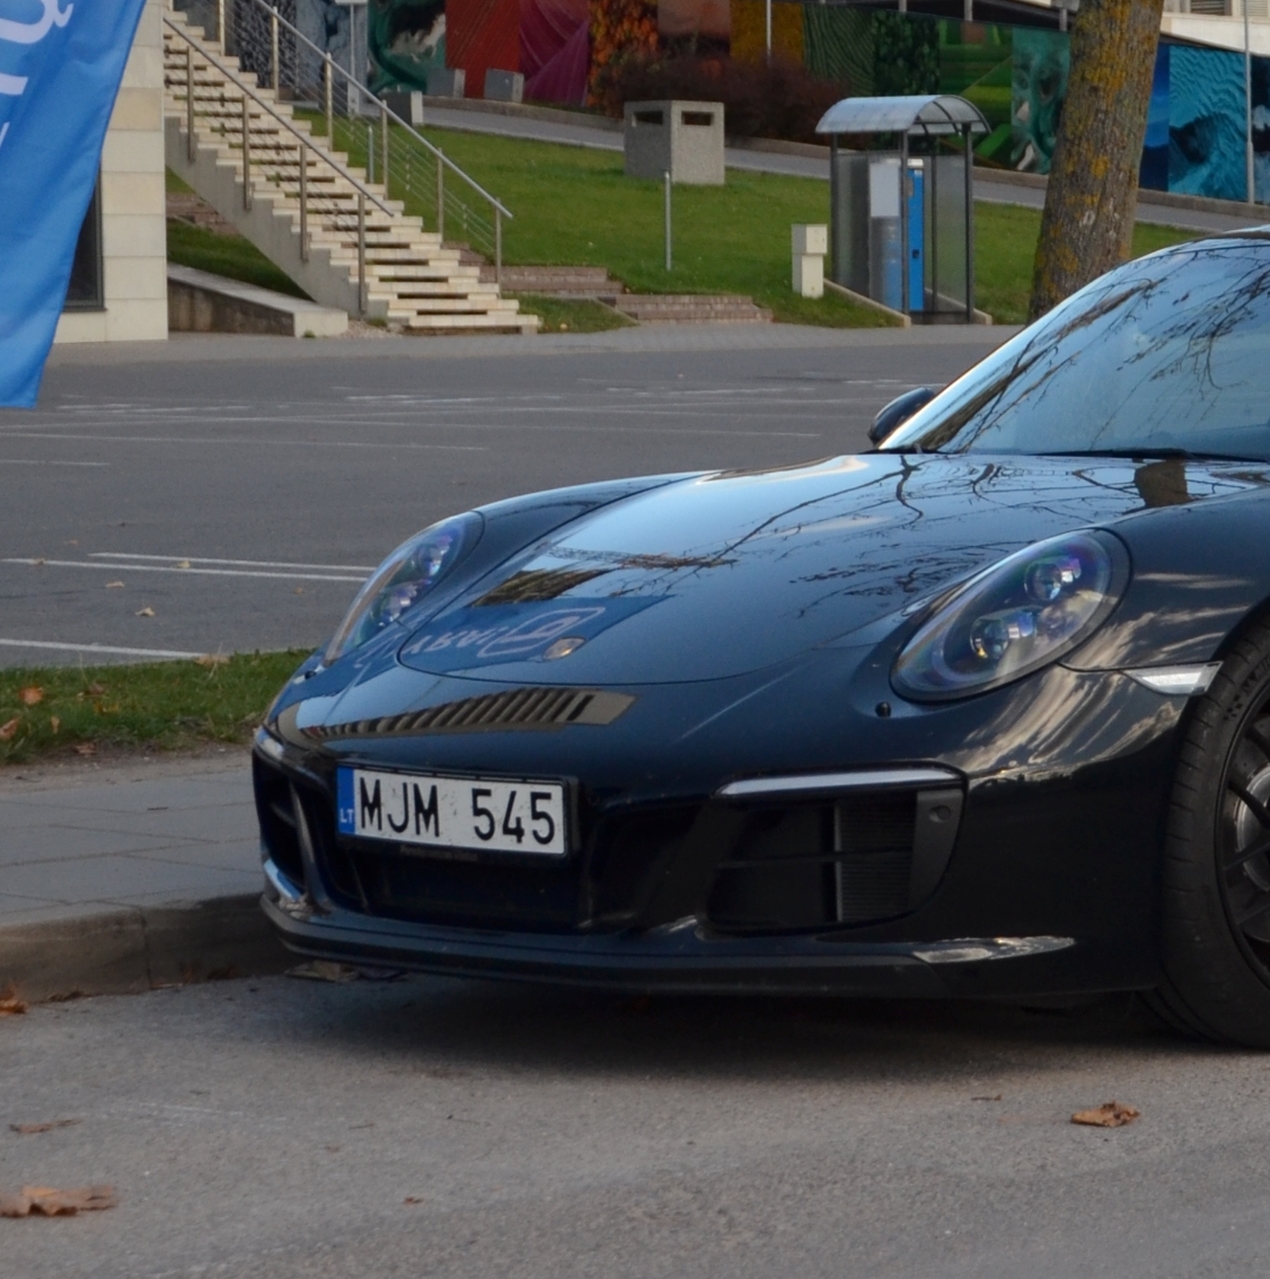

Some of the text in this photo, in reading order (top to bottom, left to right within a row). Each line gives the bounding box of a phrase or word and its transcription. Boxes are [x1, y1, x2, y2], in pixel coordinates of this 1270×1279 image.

[340, 808, 354, 825] LT
[360, 777, 555, 846] MJM 545
